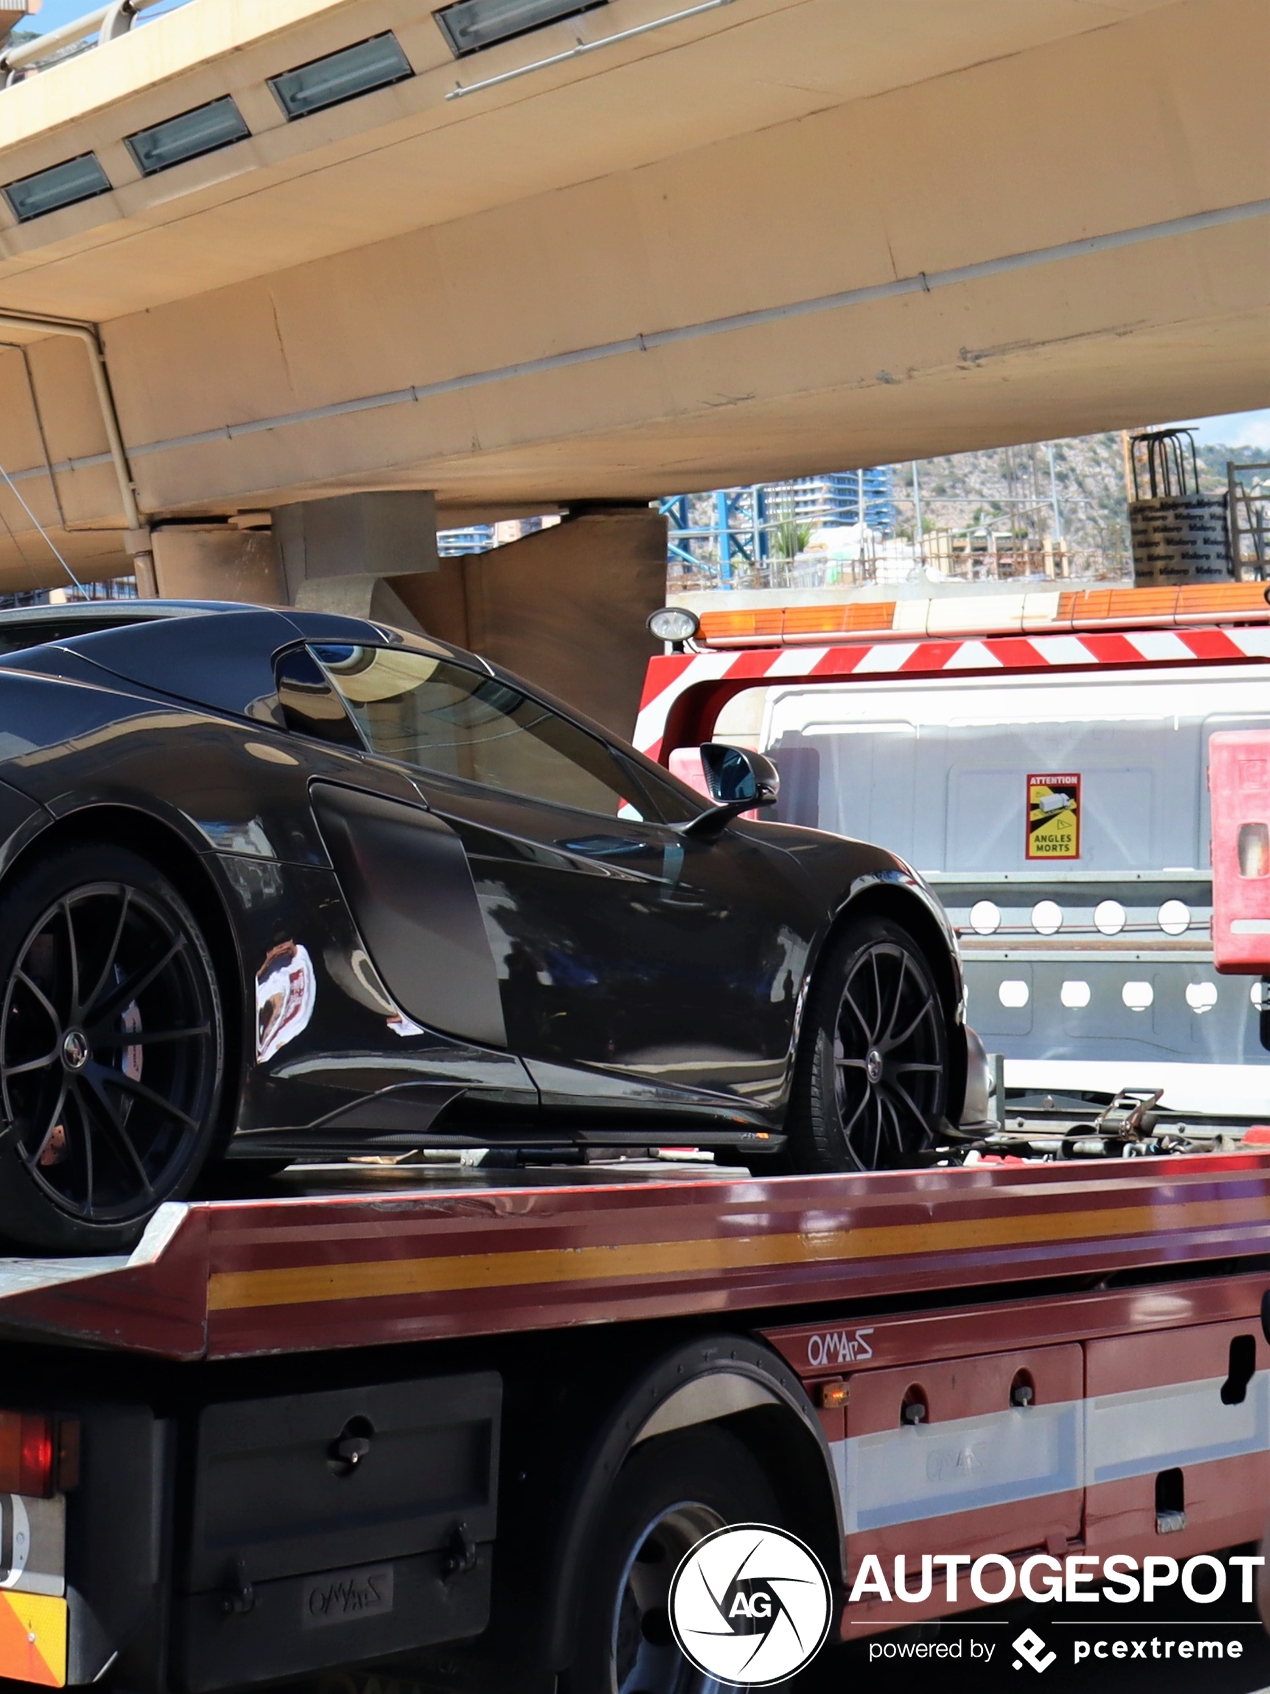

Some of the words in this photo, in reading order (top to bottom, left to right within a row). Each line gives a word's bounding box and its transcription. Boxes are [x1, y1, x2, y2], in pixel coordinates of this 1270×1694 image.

[1030, 776, 1077, 785] ATTENTION
[1034, 834, 1072, 843] ANGLES
[1036, 844, 1070, 852] MORTS
